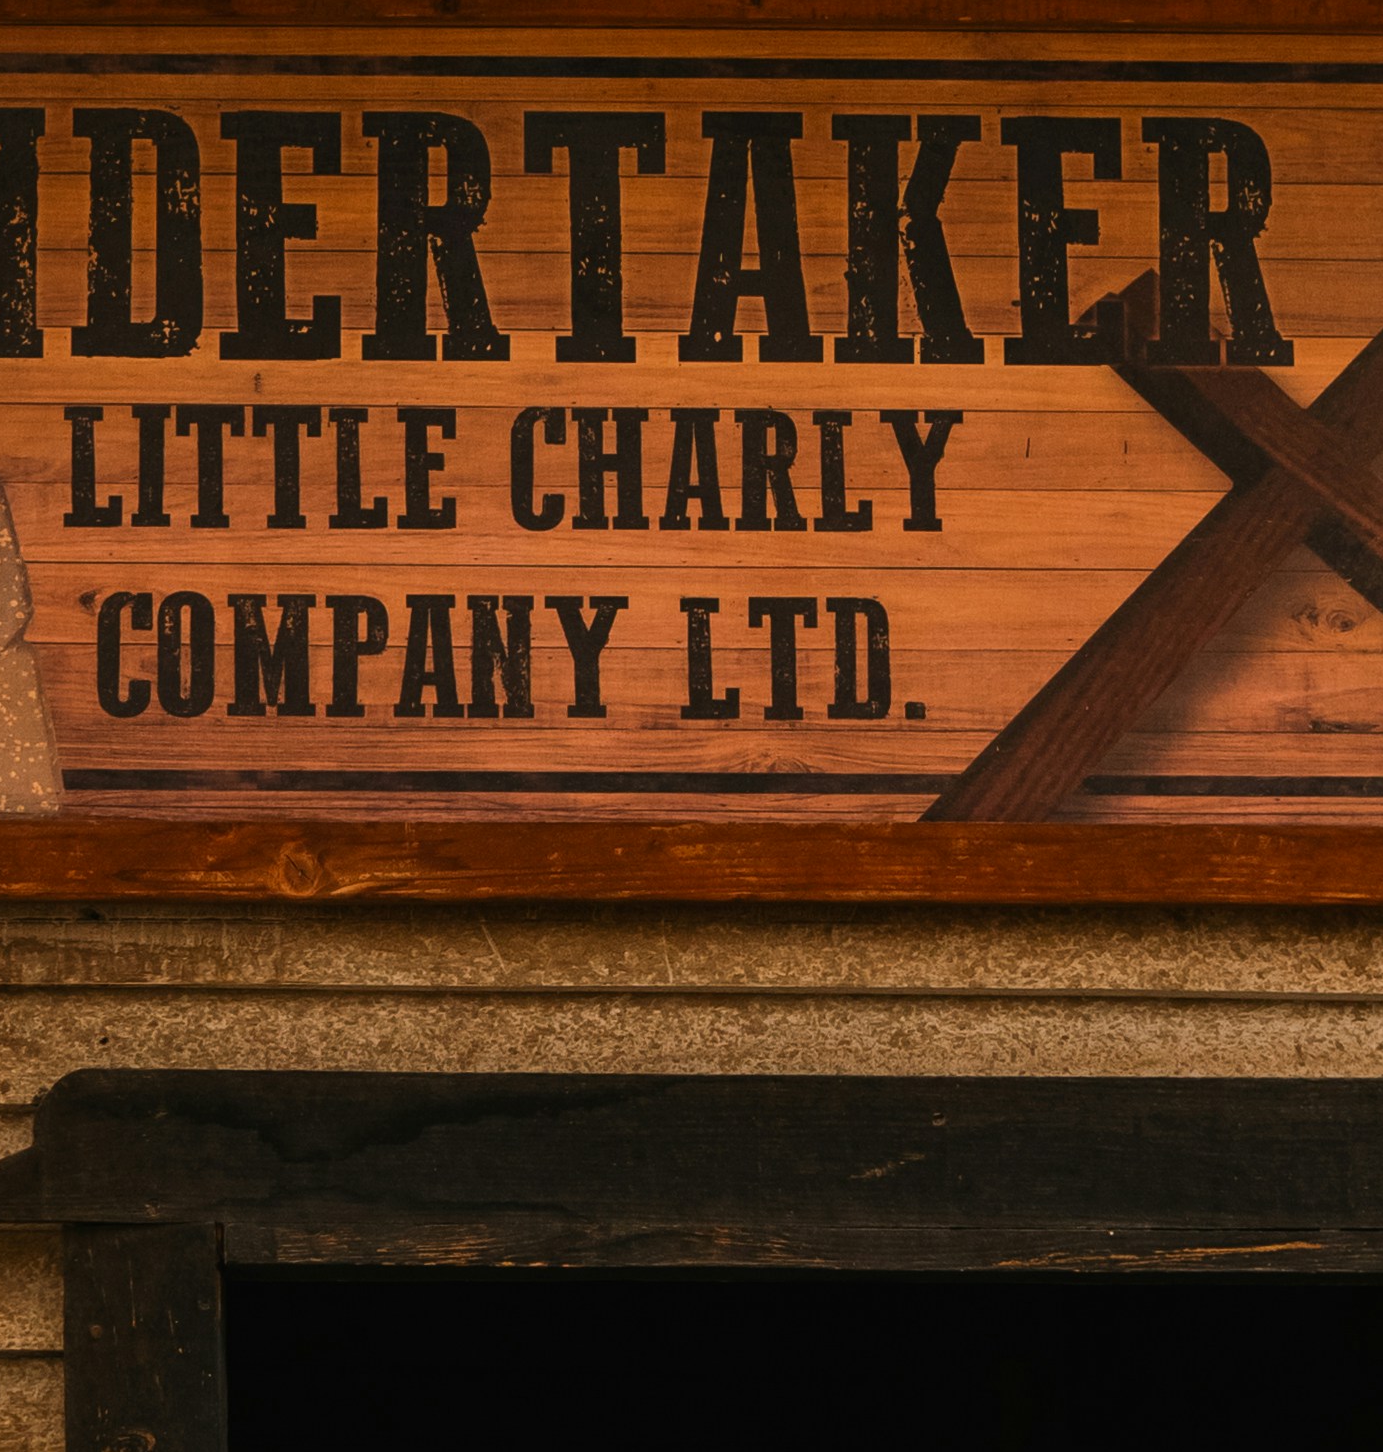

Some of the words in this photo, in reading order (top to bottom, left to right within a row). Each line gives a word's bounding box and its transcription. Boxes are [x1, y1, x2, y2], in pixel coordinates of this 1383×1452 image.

[62, 404, 458, 530] LITTLE
[509, 406, 964, 533] CHARLY
[96, 590, 630, 719] COMPANY
[679, 596, 927, 721] LTD.
